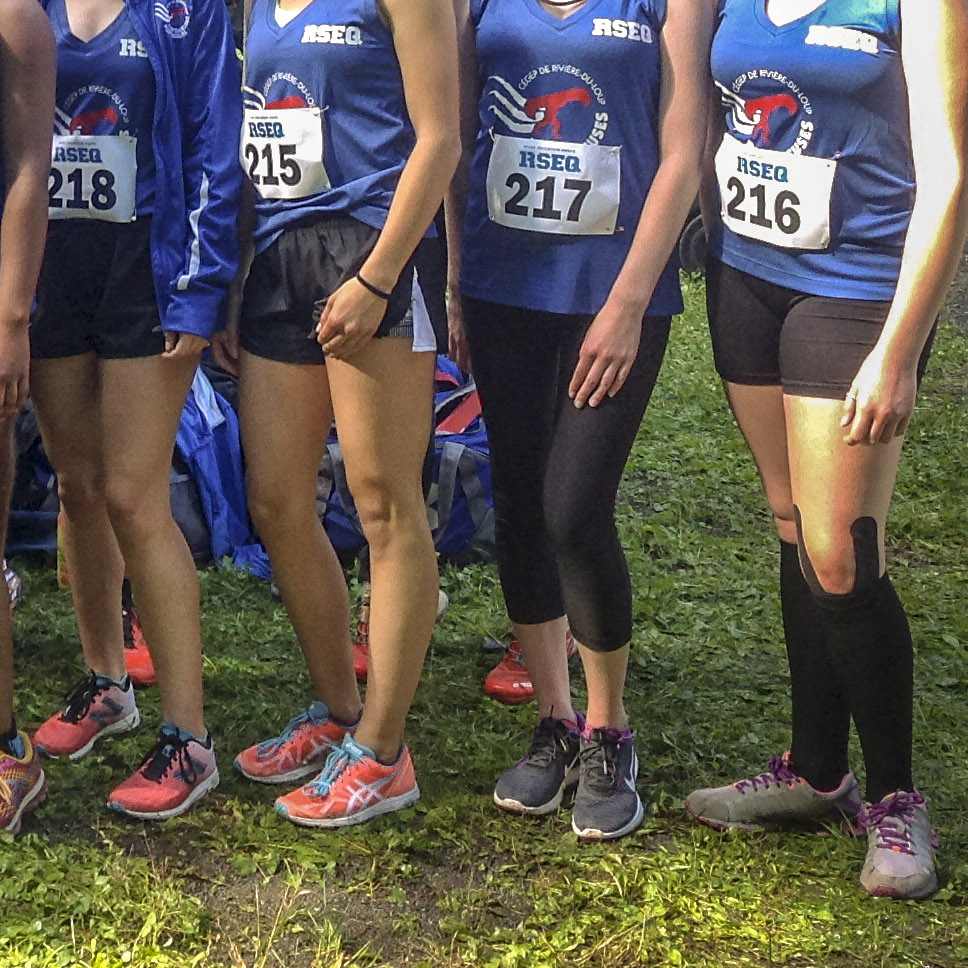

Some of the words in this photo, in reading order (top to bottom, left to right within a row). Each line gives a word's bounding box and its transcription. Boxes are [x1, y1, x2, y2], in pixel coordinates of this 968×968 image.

[301, 24, 363, 46] RSEQ
[592, 18, 653, 44] RSEQ
[119, 38, 149, 58] RS
[248, 121, 285, 139] RSEQ
[53, 147, 103, 164] RSEQ
[244, 143, 302, 187] 215
[519, 150, 581, 173] RSEQ
[737, 156, 789, 183] RSEQ
[48, 168, 117, 210] 218
[504, 173, 593, 222] 217
[726, 177, 801, 234] 216
